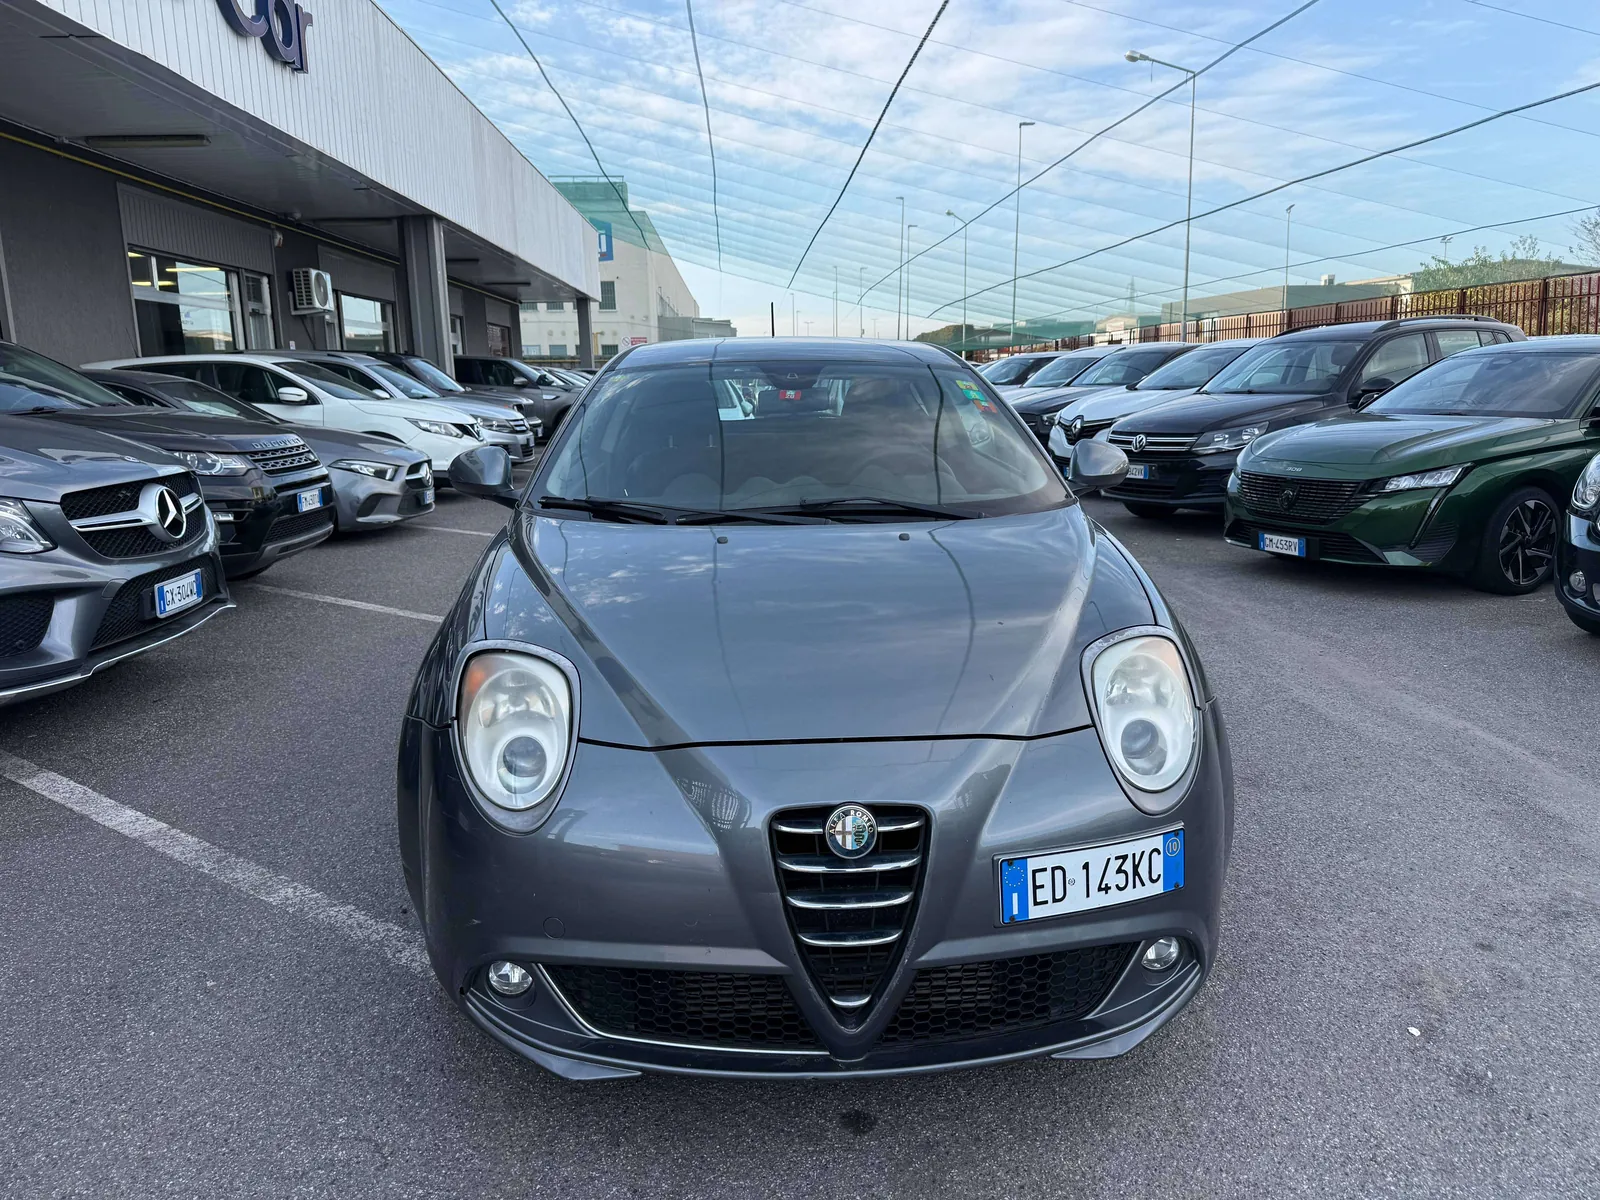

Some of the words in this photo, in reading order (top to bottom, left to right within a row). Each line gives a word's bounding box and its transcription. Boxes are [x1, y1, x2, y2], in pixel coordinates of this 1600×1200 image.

[850, 809, 874, 833] ROMEO
[1031, 865, 1067, 907] ED
[1082, 847, 1162, 899] 143KC
